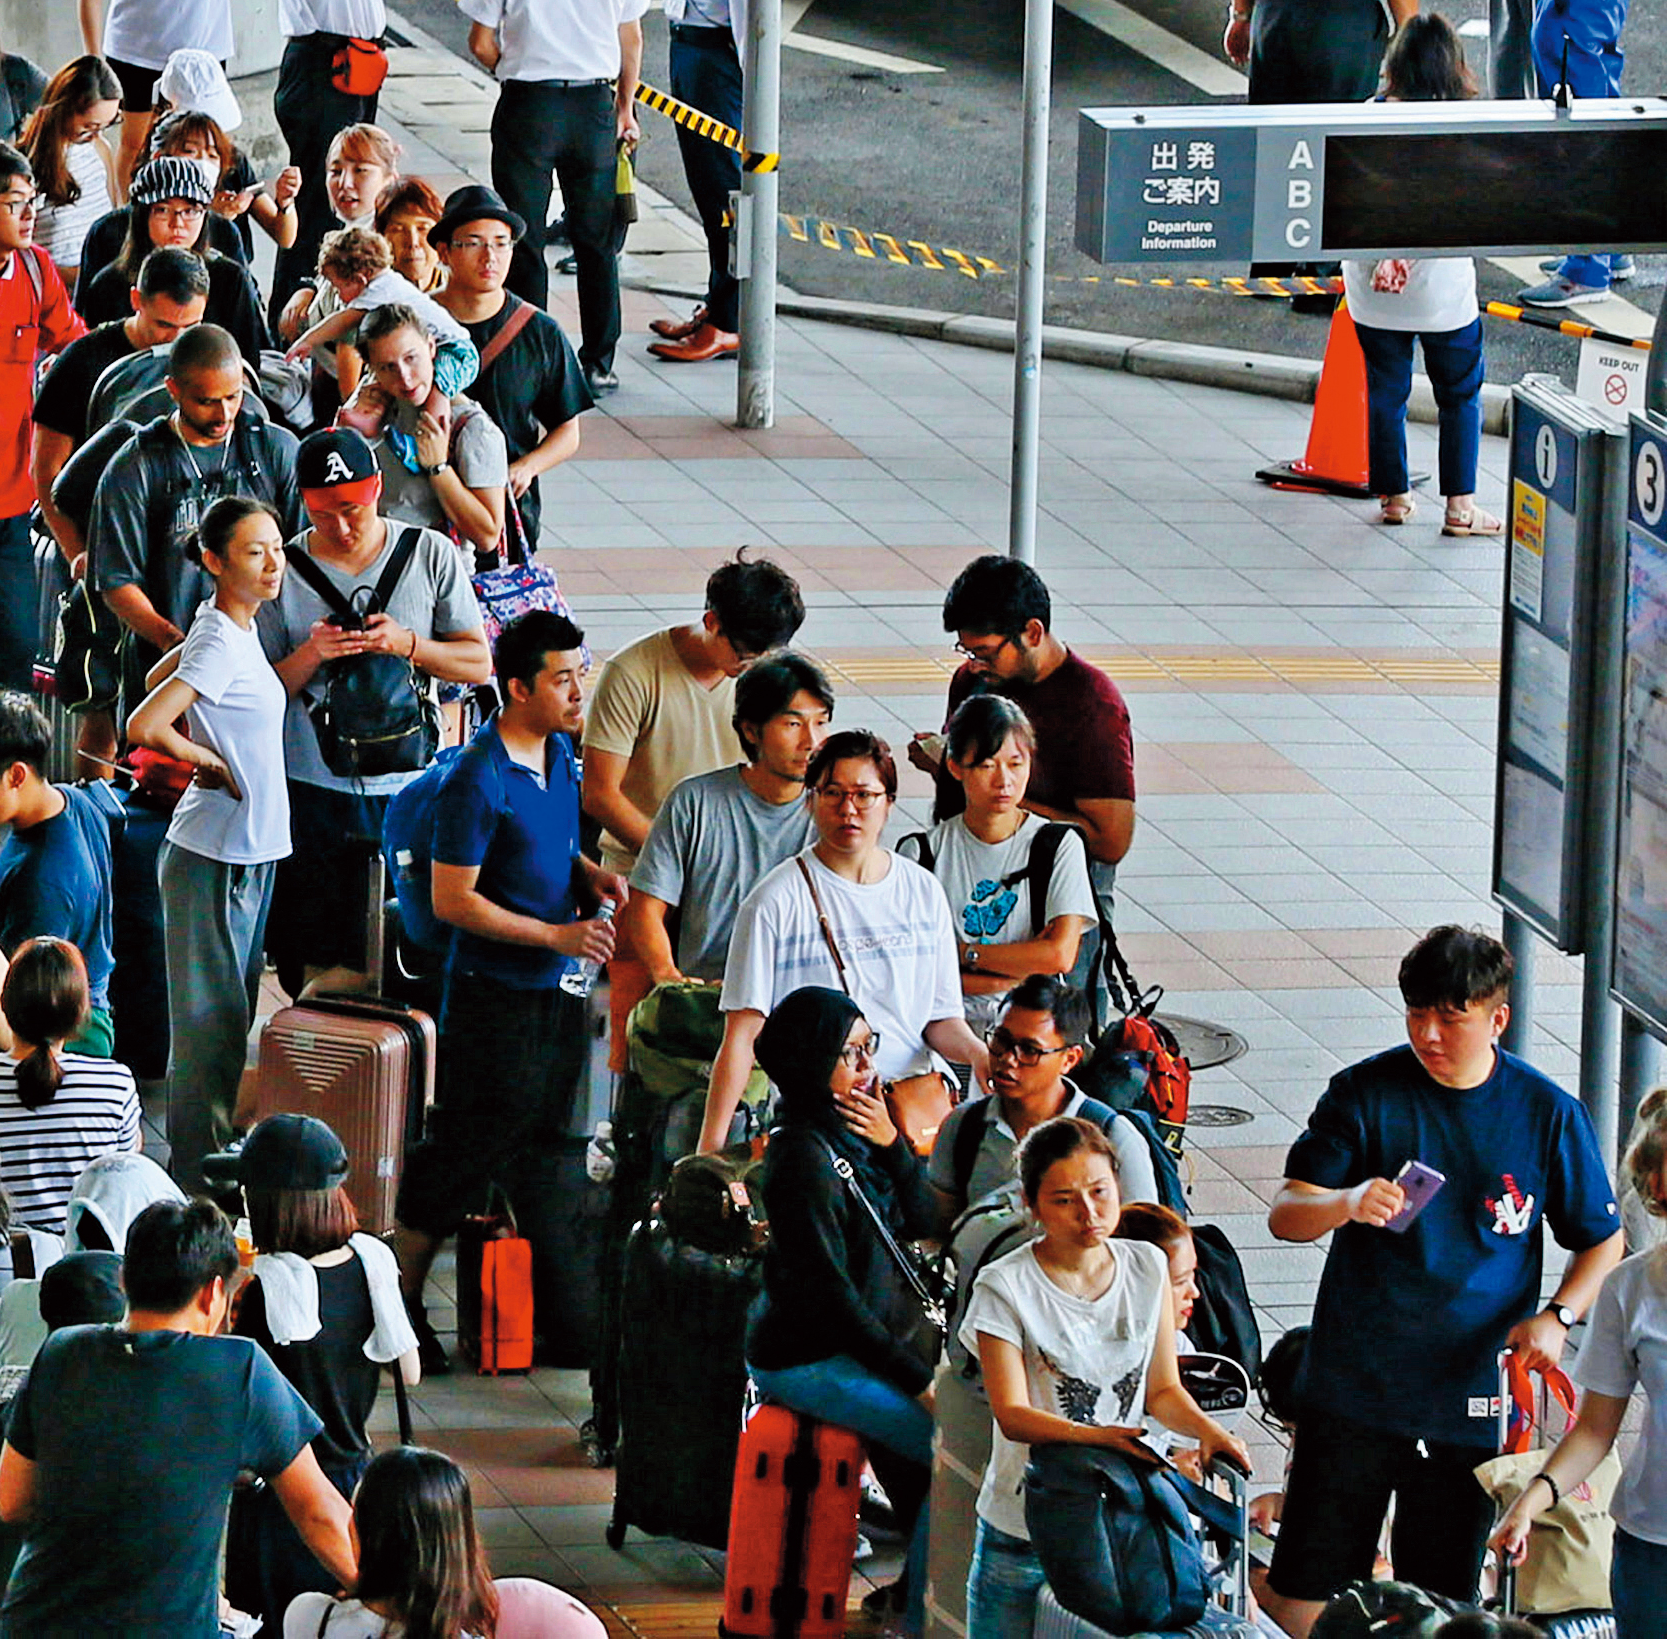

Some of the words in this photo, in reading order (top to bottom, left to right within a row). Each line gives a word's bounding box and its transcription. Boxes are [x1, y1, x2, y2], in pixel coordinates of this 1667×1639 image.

[1151, 141, 1215, 171] 出発
[1288, 141, 1314, 170] A
[1143, 177, 1221, 206] ご案内
[1287, 180, 1312, 208] B
[1147, 219, 1213, 236] Departure
[1285, 220, 1311, 249] C
[1142, 235, 1217, 251] Information
[1598, 354, 1620, 372] KEEP
[1620, 358, 1640, 374] OUT
[1638, 453, 1657, 512] 3
